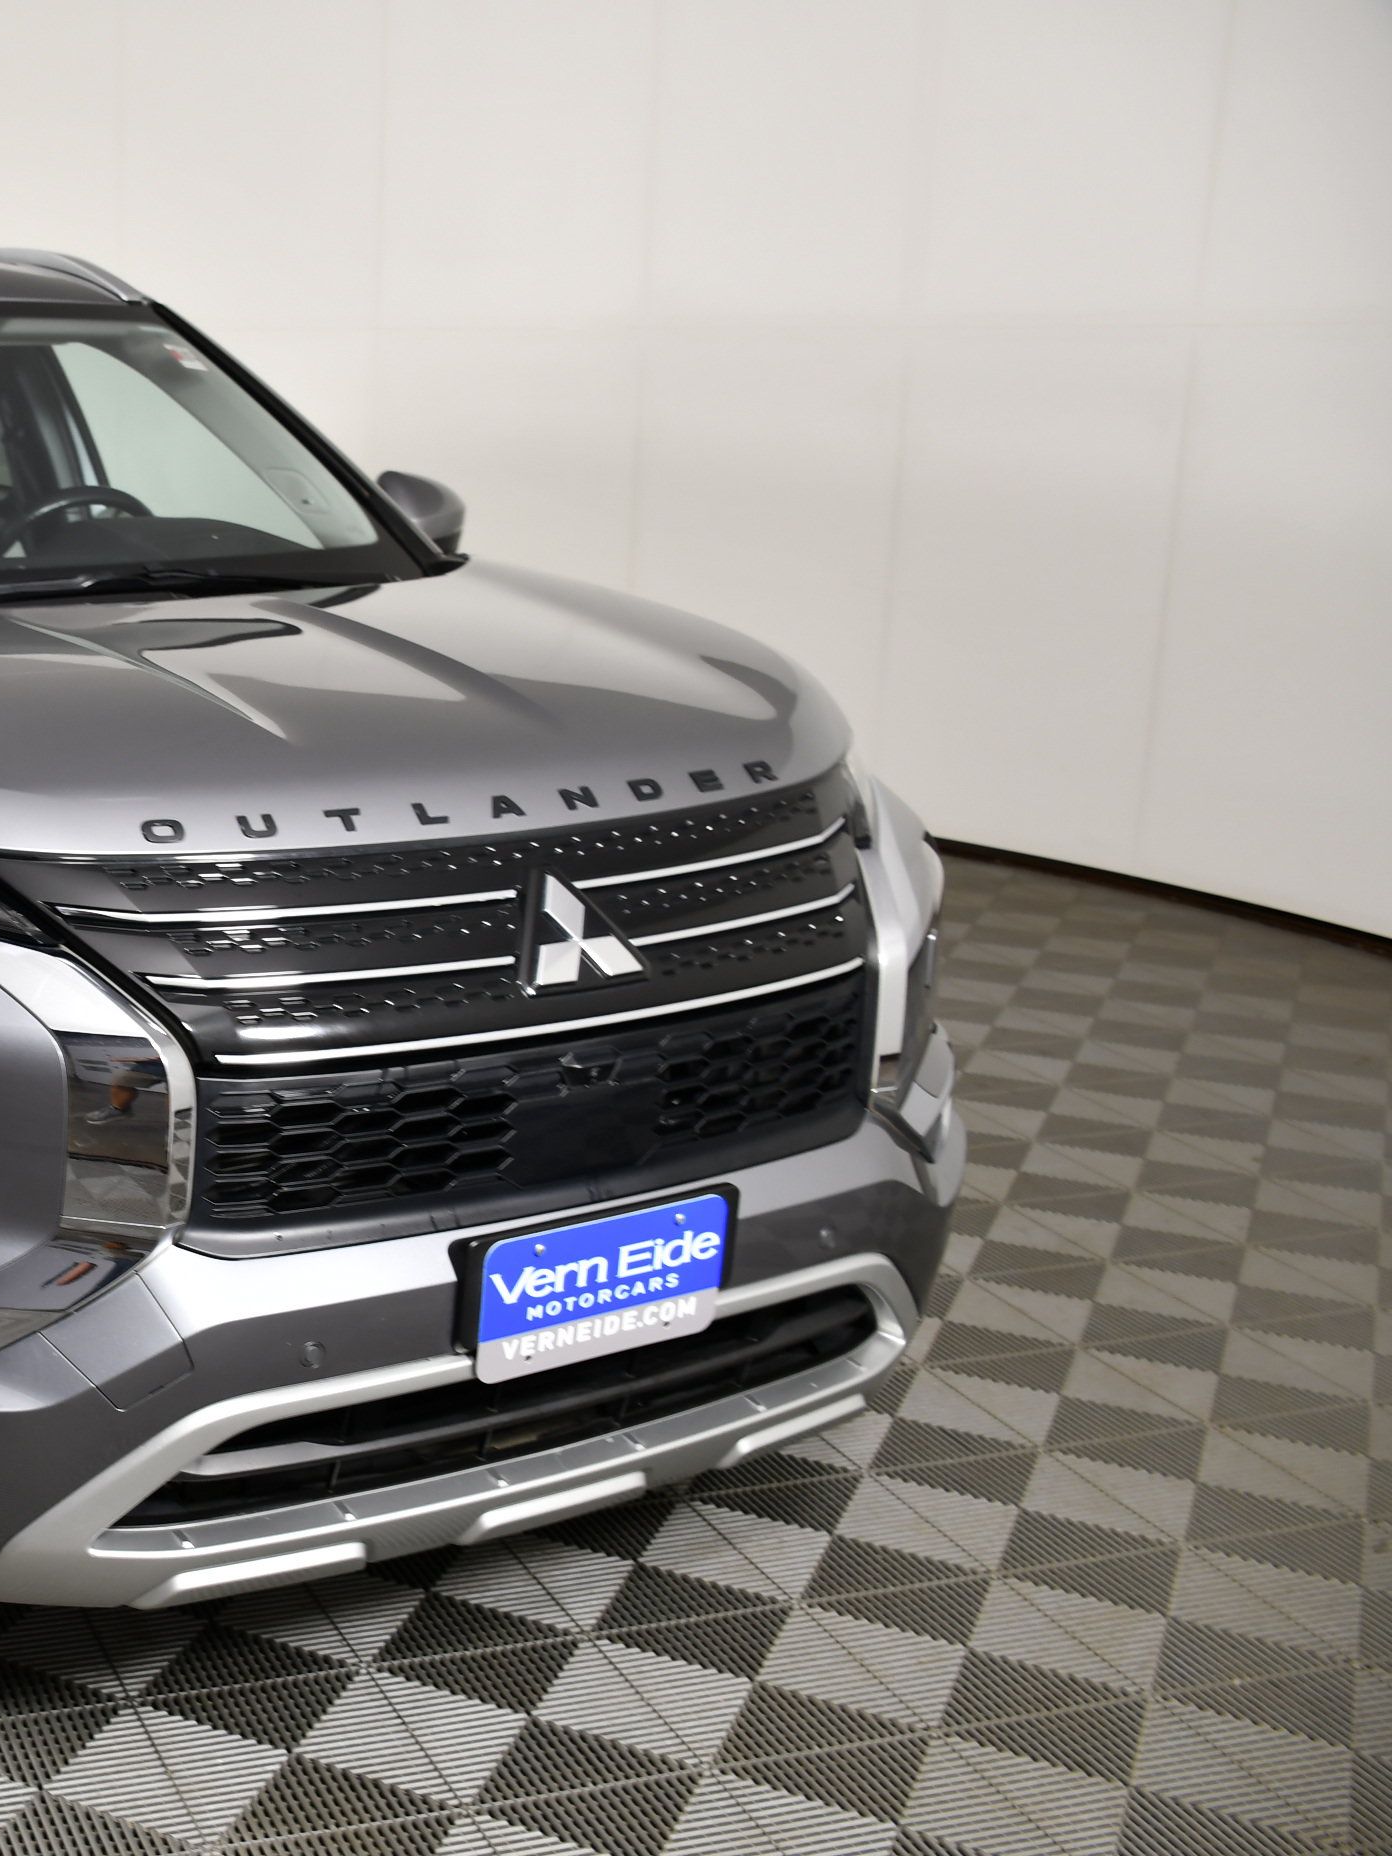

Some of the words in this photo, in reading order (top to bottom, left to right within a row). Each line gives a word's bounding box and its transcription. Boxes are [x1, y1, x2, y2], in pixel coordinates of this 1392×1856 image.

[140, 759, 779, 844] OUTLANDER
[489, 1255, 608, 1304] Vern
[617, 1230, 721, 1278] Eide
[525, 1273, 680, 1321] MOTORCARS
[501, 1296, 697, 1361] VERNEIDE.COM
